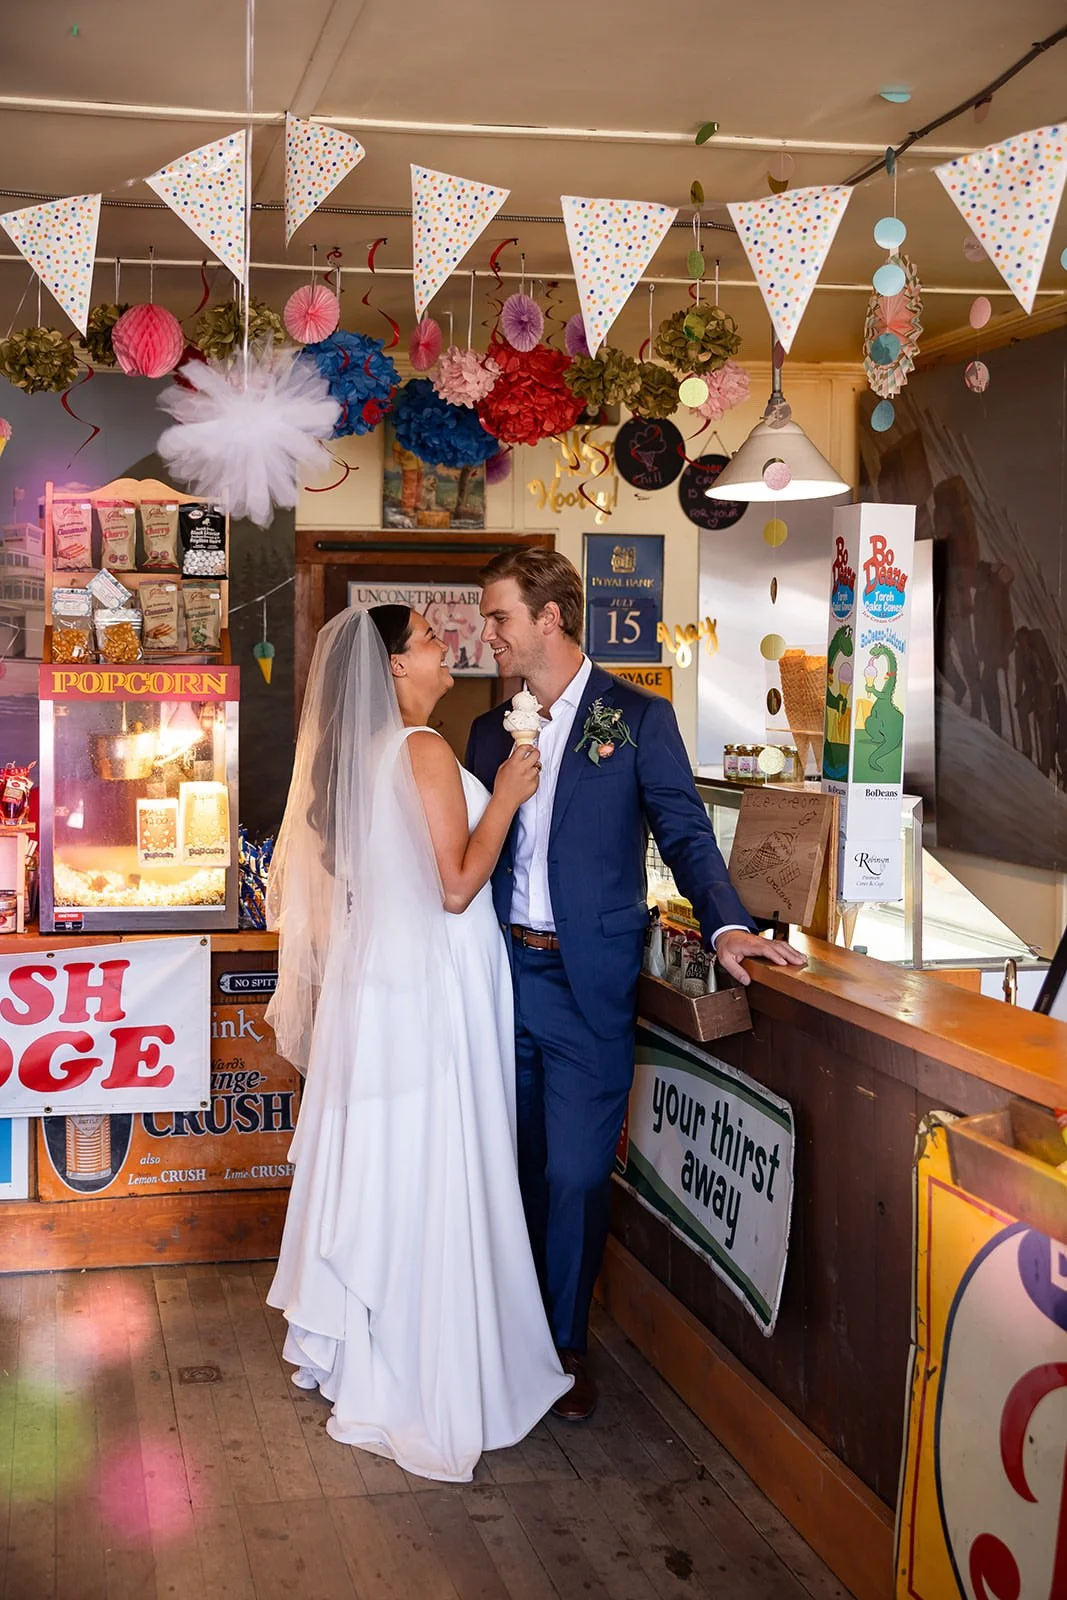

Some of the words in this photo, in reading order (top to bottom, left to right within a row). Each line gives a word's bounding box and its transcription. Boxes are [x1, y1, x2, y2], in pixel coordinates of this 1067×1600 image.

[870, 535, 895, 567] Bo
[863, 556, 908, 595] Deans
[610, 598, 634, 607] JULY
[607, 610, 641, 644] 15
[51, 671, 228, 695] POPCORN
[865, 788, 899, 797] BoDeans
[234, 979, 250, 988] NO
[141, 1092, 296, 1139] CRUSH
[652, 1076, 705, 1142] your
[710, 1099, 780, 1203] thirst
[139, 1153, 161, 1166] also
[680, 1148, 742, 1250] away
